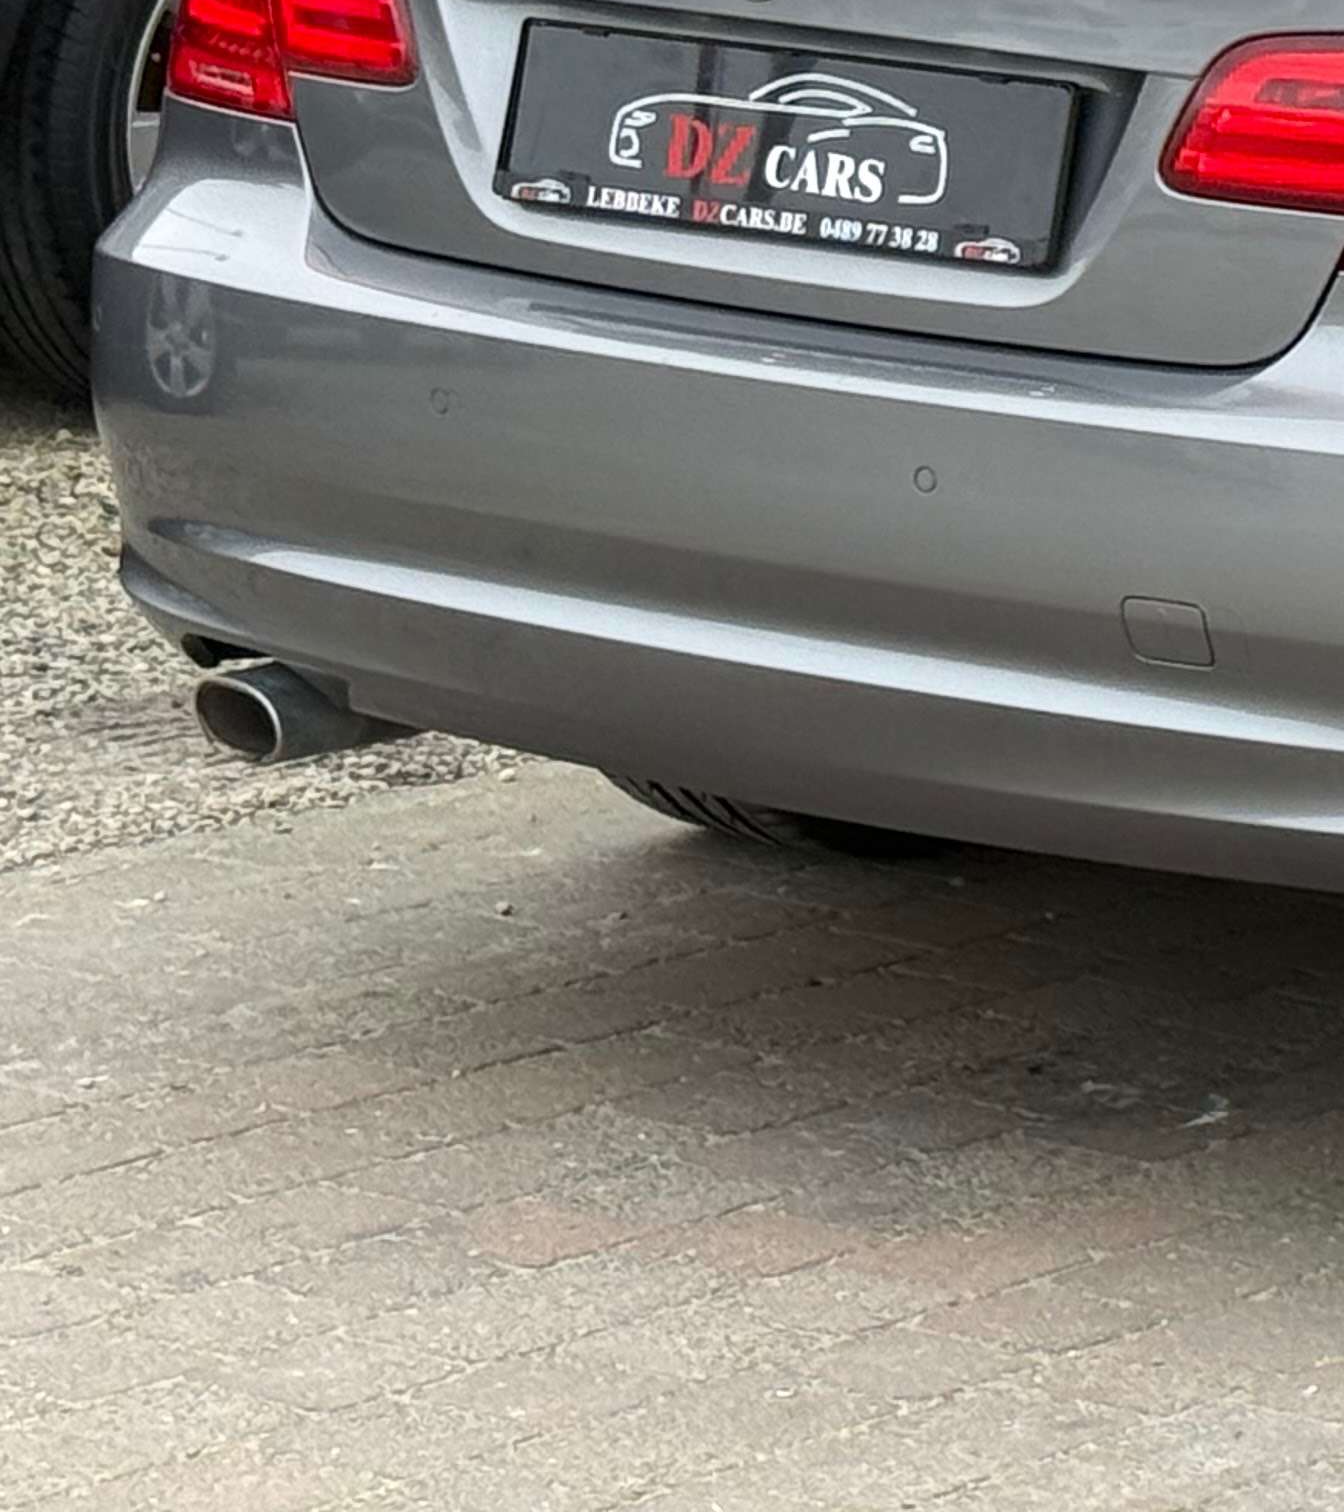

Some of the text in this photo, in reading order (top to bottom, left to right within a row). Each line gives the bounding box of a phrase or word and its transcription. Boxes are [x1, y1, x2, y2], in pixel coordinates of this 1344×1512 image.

[665, 112, 886, 203] DZ CARS
[693, 199, 807, 235] DZCARS.BE
[819, 217, 863, 243] 0489
[866, 222, 889, 249] 77
[888, 225, 913, 251] 38
[914, 230, 939, 253] 28
